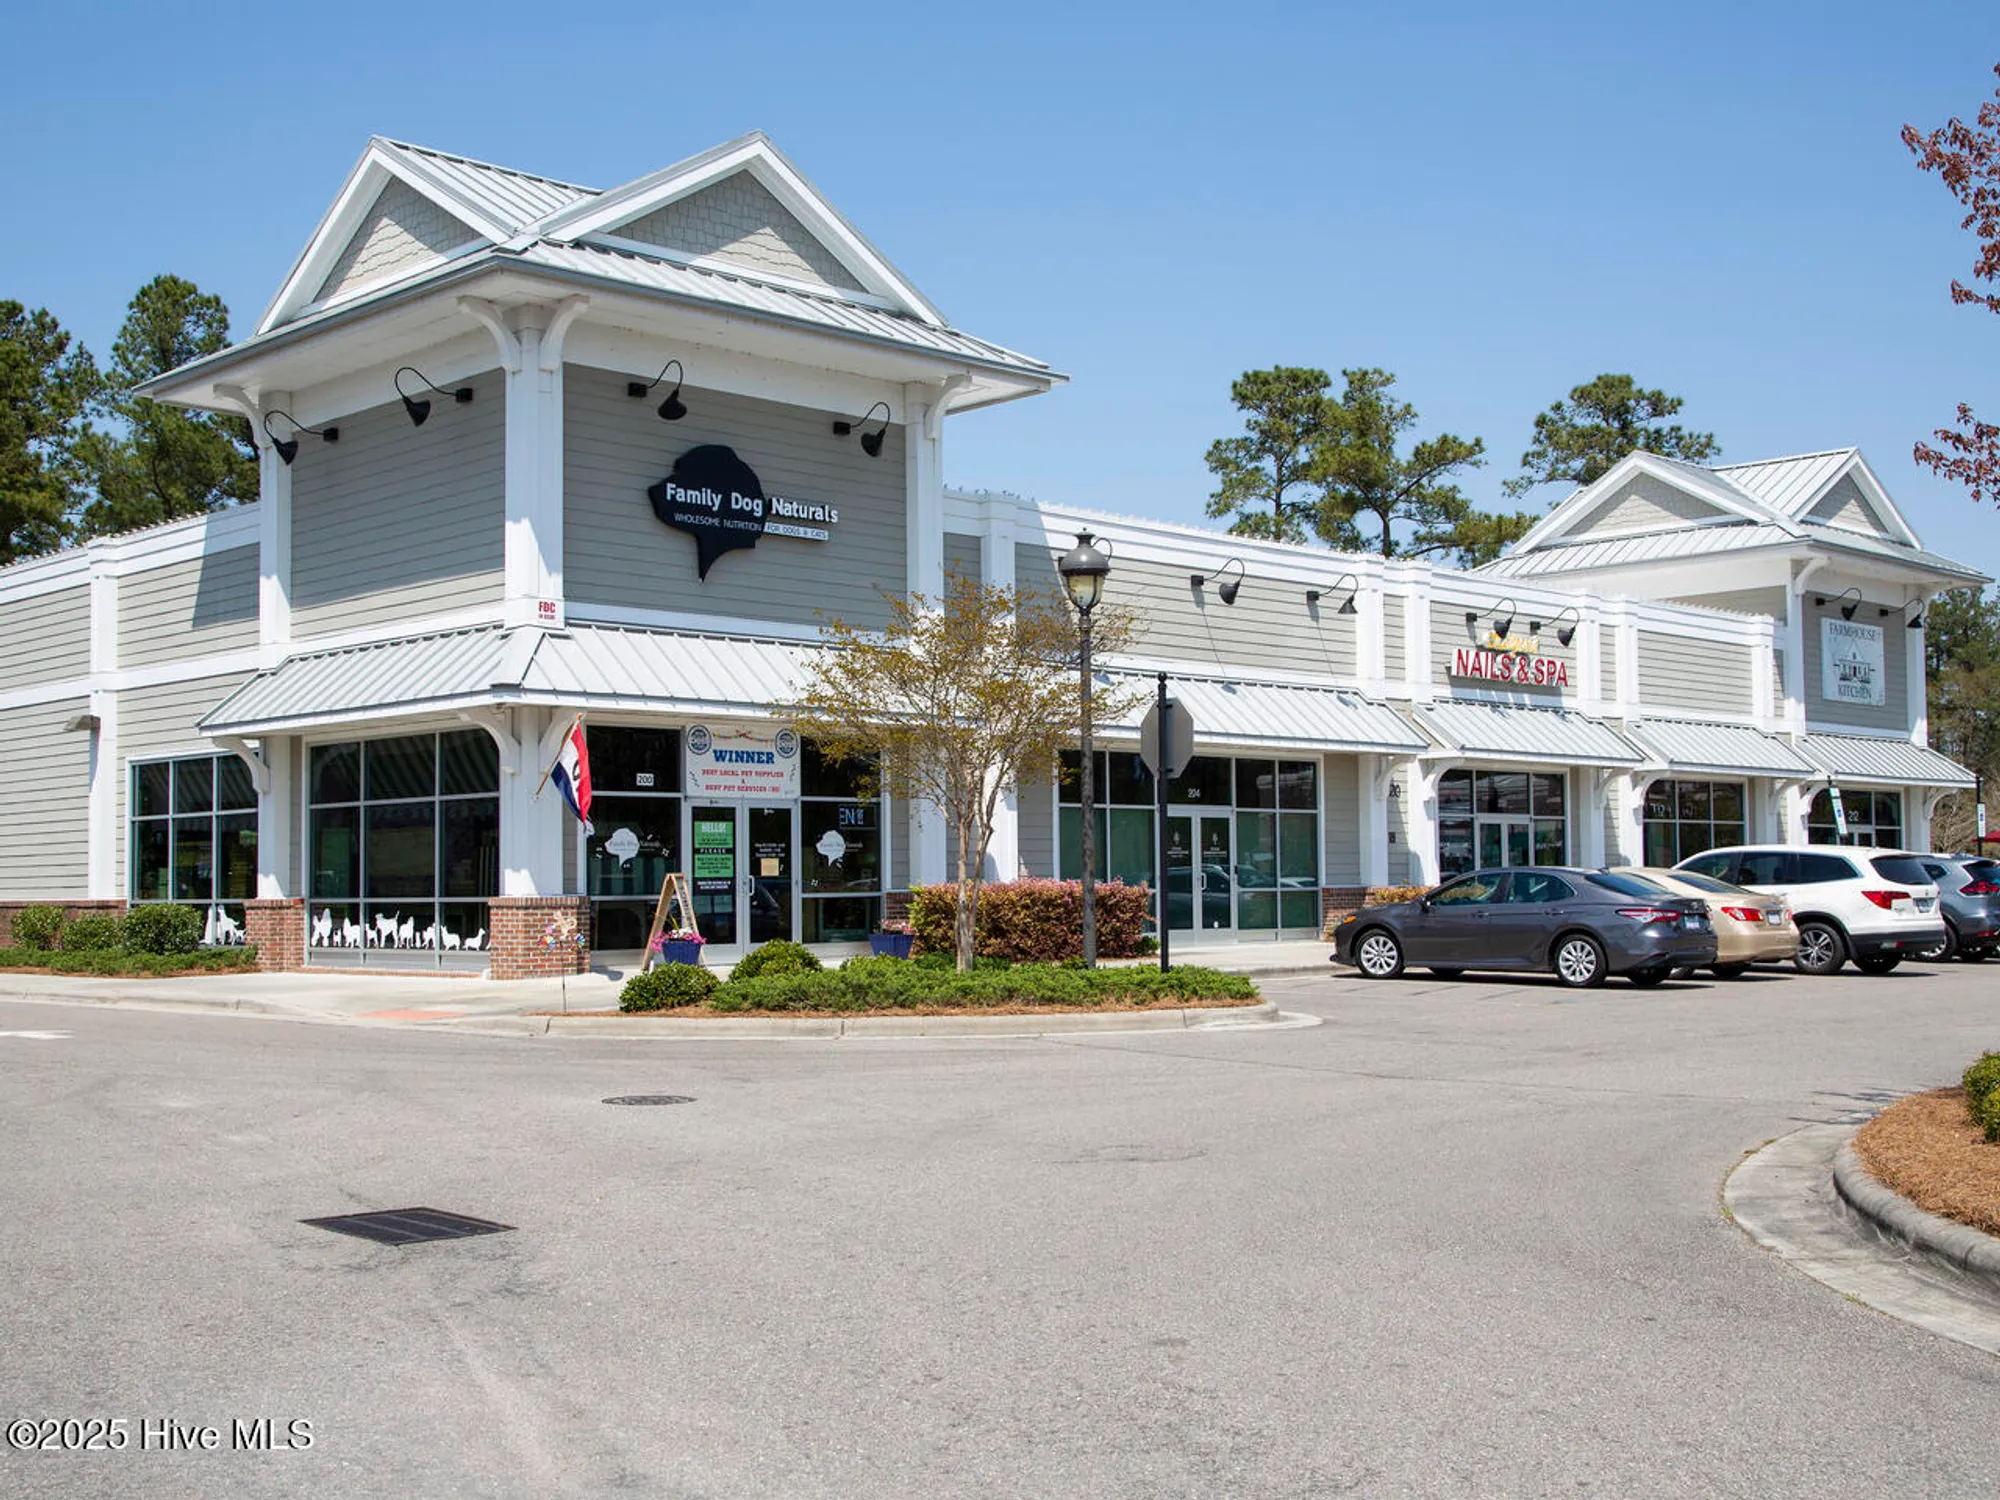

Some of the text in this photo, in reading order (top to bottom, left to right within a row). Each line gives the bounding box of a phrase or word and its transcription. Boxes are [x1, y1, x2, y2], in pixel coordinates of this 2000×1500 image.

[666, 482, 839, 524] Family Dog Naturals
[674, 512, 719, 527] WHOLESOME
[723, 518, 762, 531] NUTRITION
[538, 601, 556, 613] FDC
[1829, 622, 1876, 641] FARMHOUSE
[1456, 649, 1569, 688] NAILS & SPA
[1838, 684, 1872, 699] KITCHEN
[713, 749, 775, 764] WINNER
[638, 775, 653, 784] 200
